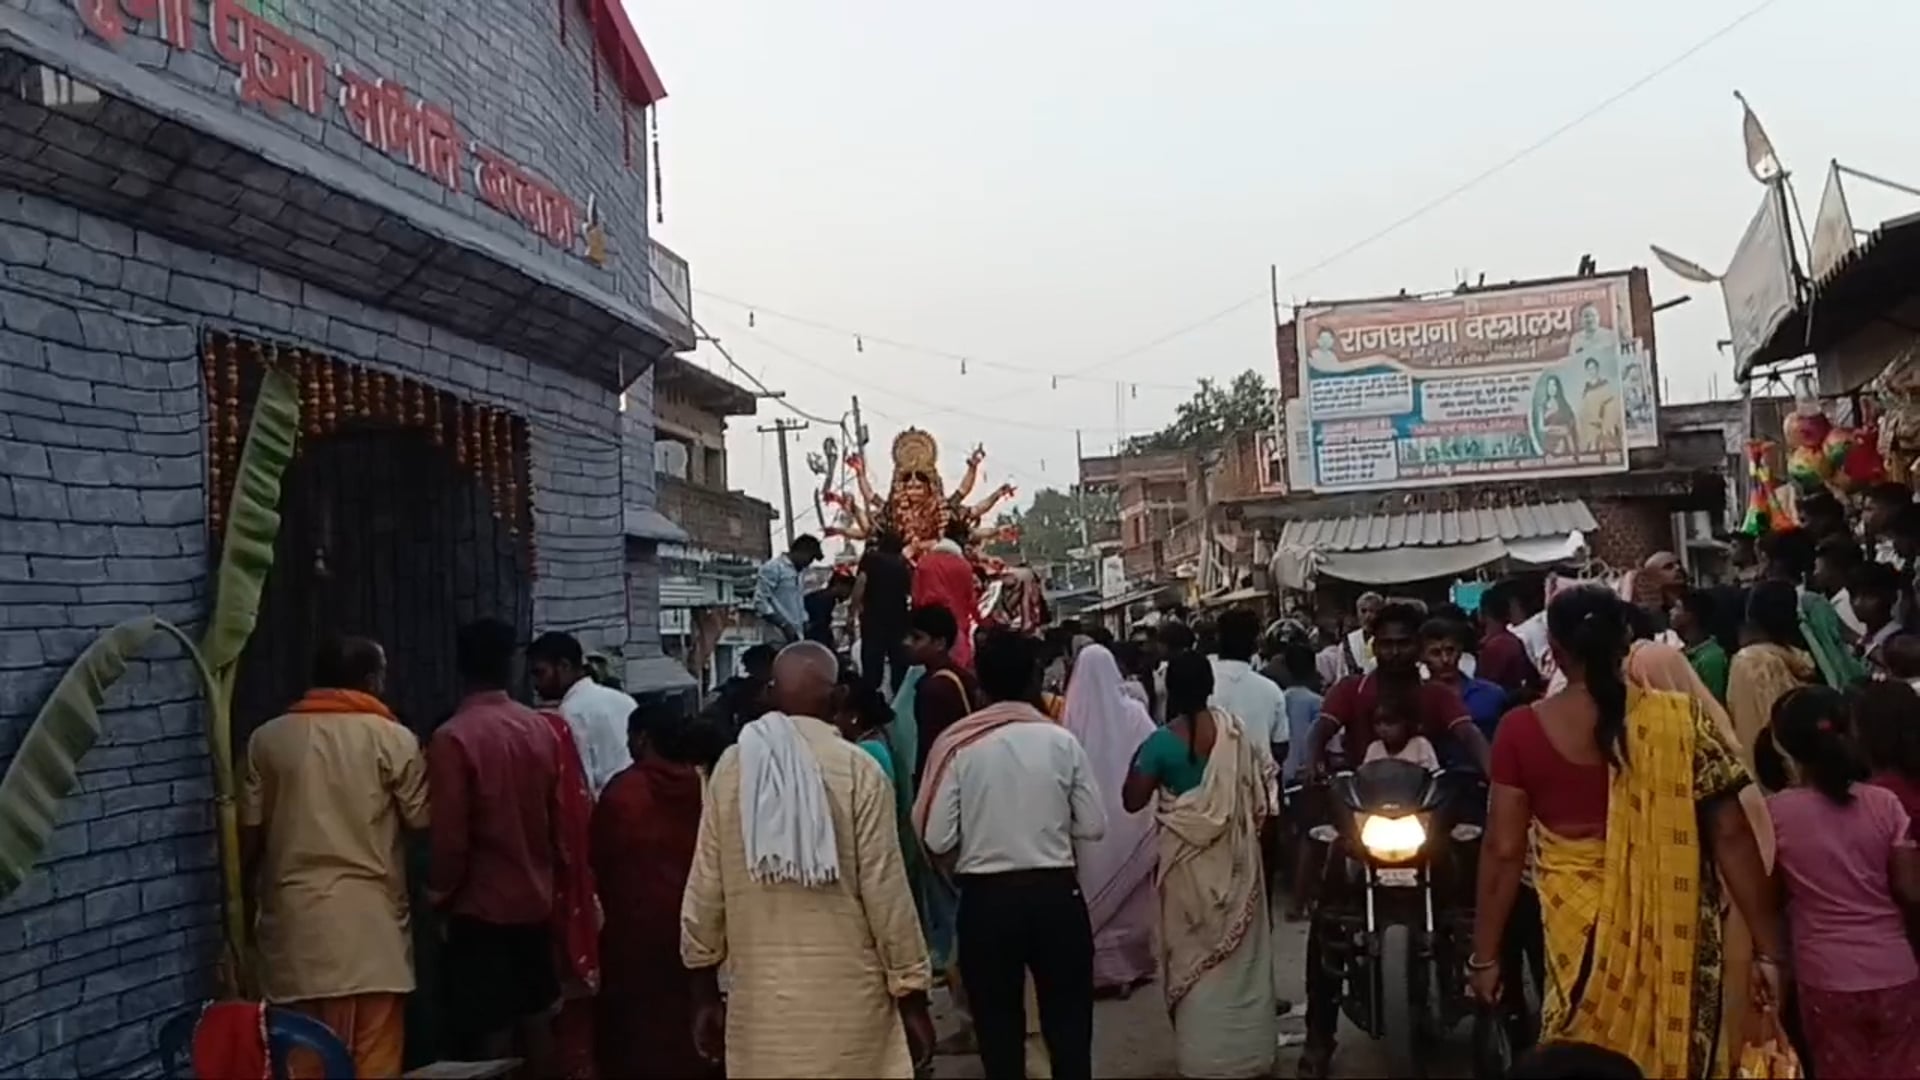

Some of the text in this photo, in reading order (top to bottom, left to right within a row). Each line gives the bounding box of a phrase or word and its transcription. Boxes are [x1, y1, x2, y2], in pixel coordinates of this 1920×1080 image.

[207, 0, 327, 116] पूजा
[335, 63, 461, 194] समिति
[1338, 305, 1574, 353] राजघराना वस्त्रालय
